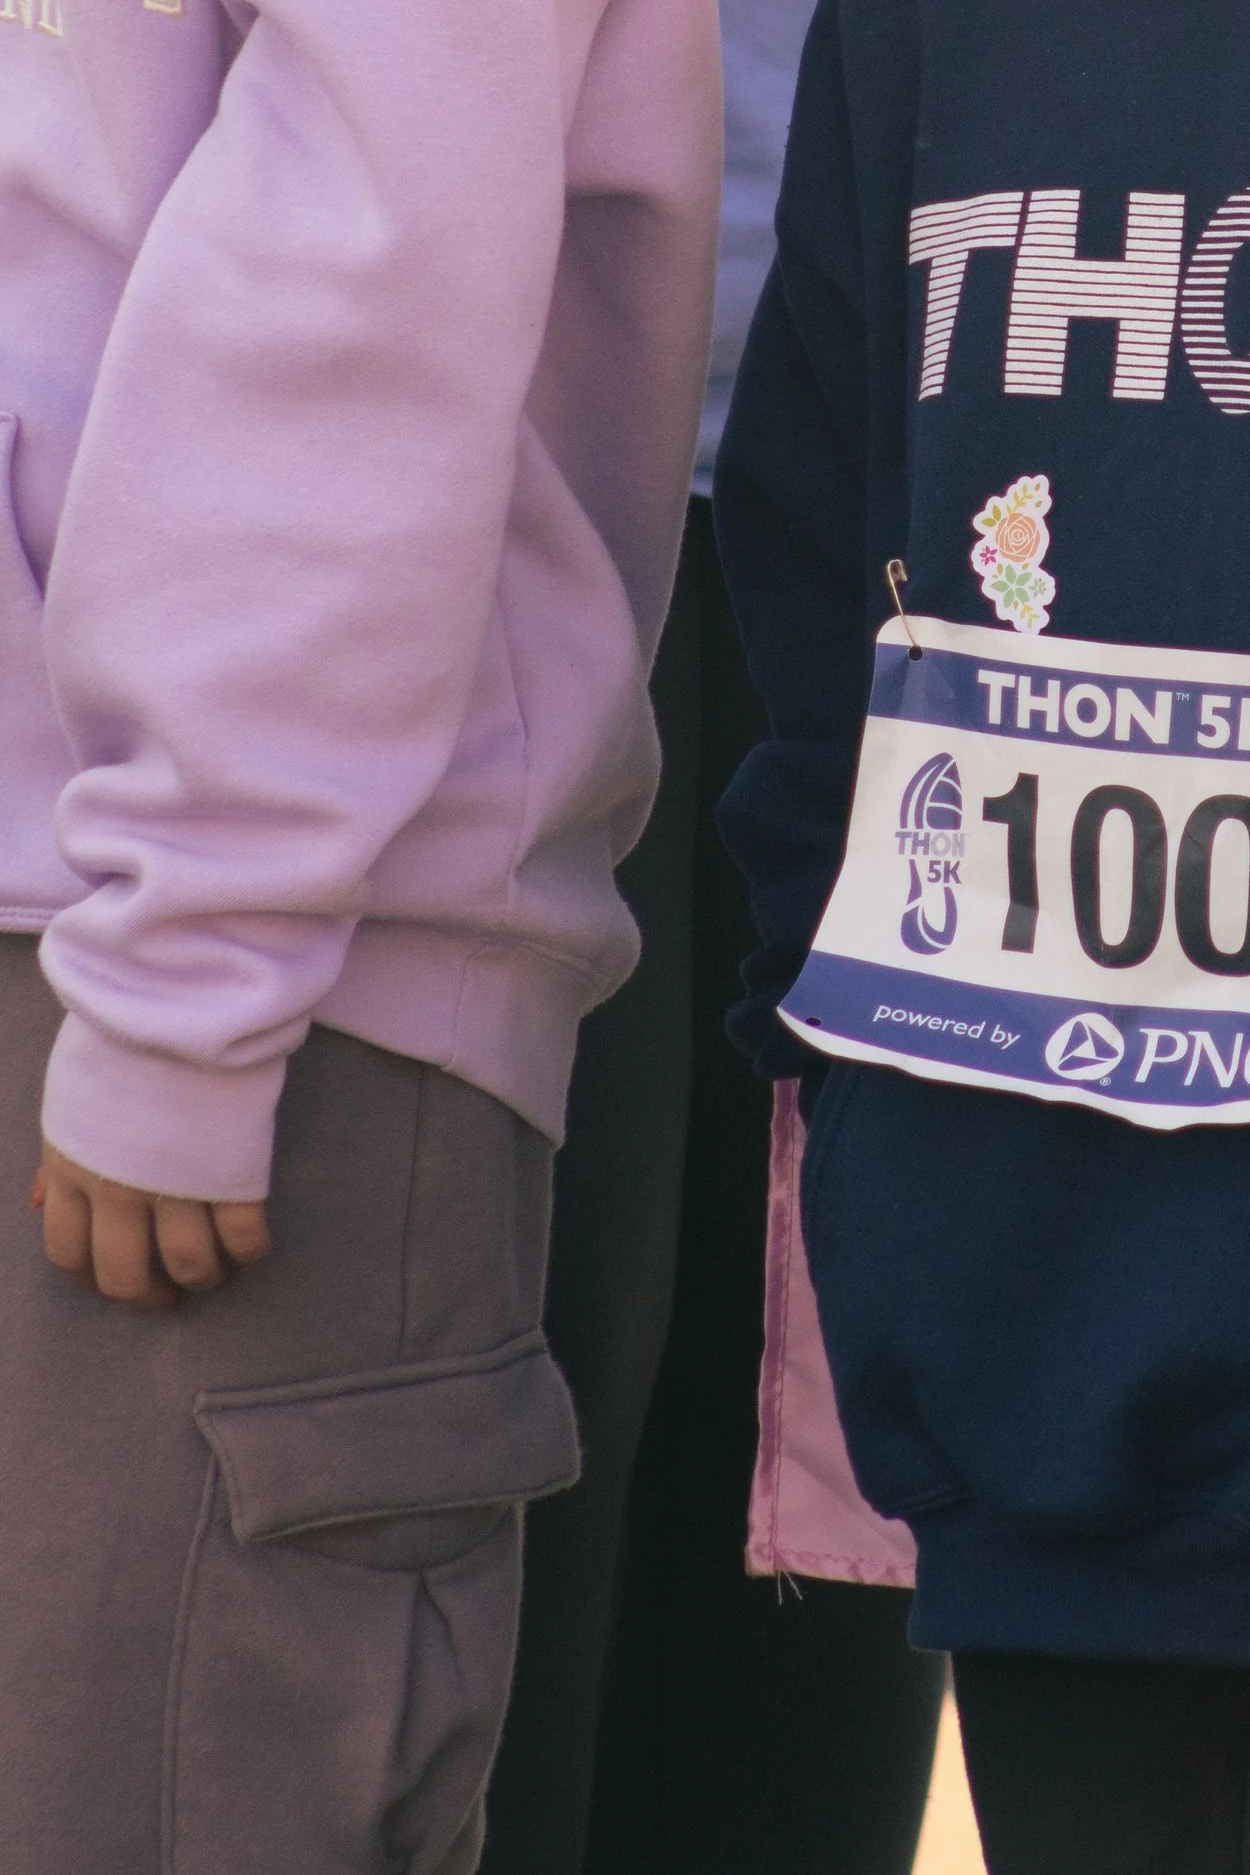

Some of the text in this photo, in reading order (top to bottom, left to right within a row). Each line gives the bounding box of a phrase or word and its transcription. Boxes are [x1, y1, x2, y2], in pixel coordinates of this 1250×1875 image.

[927, 859, 962, 884] 5K
[873, 1005, 1021, 1050] powered by
